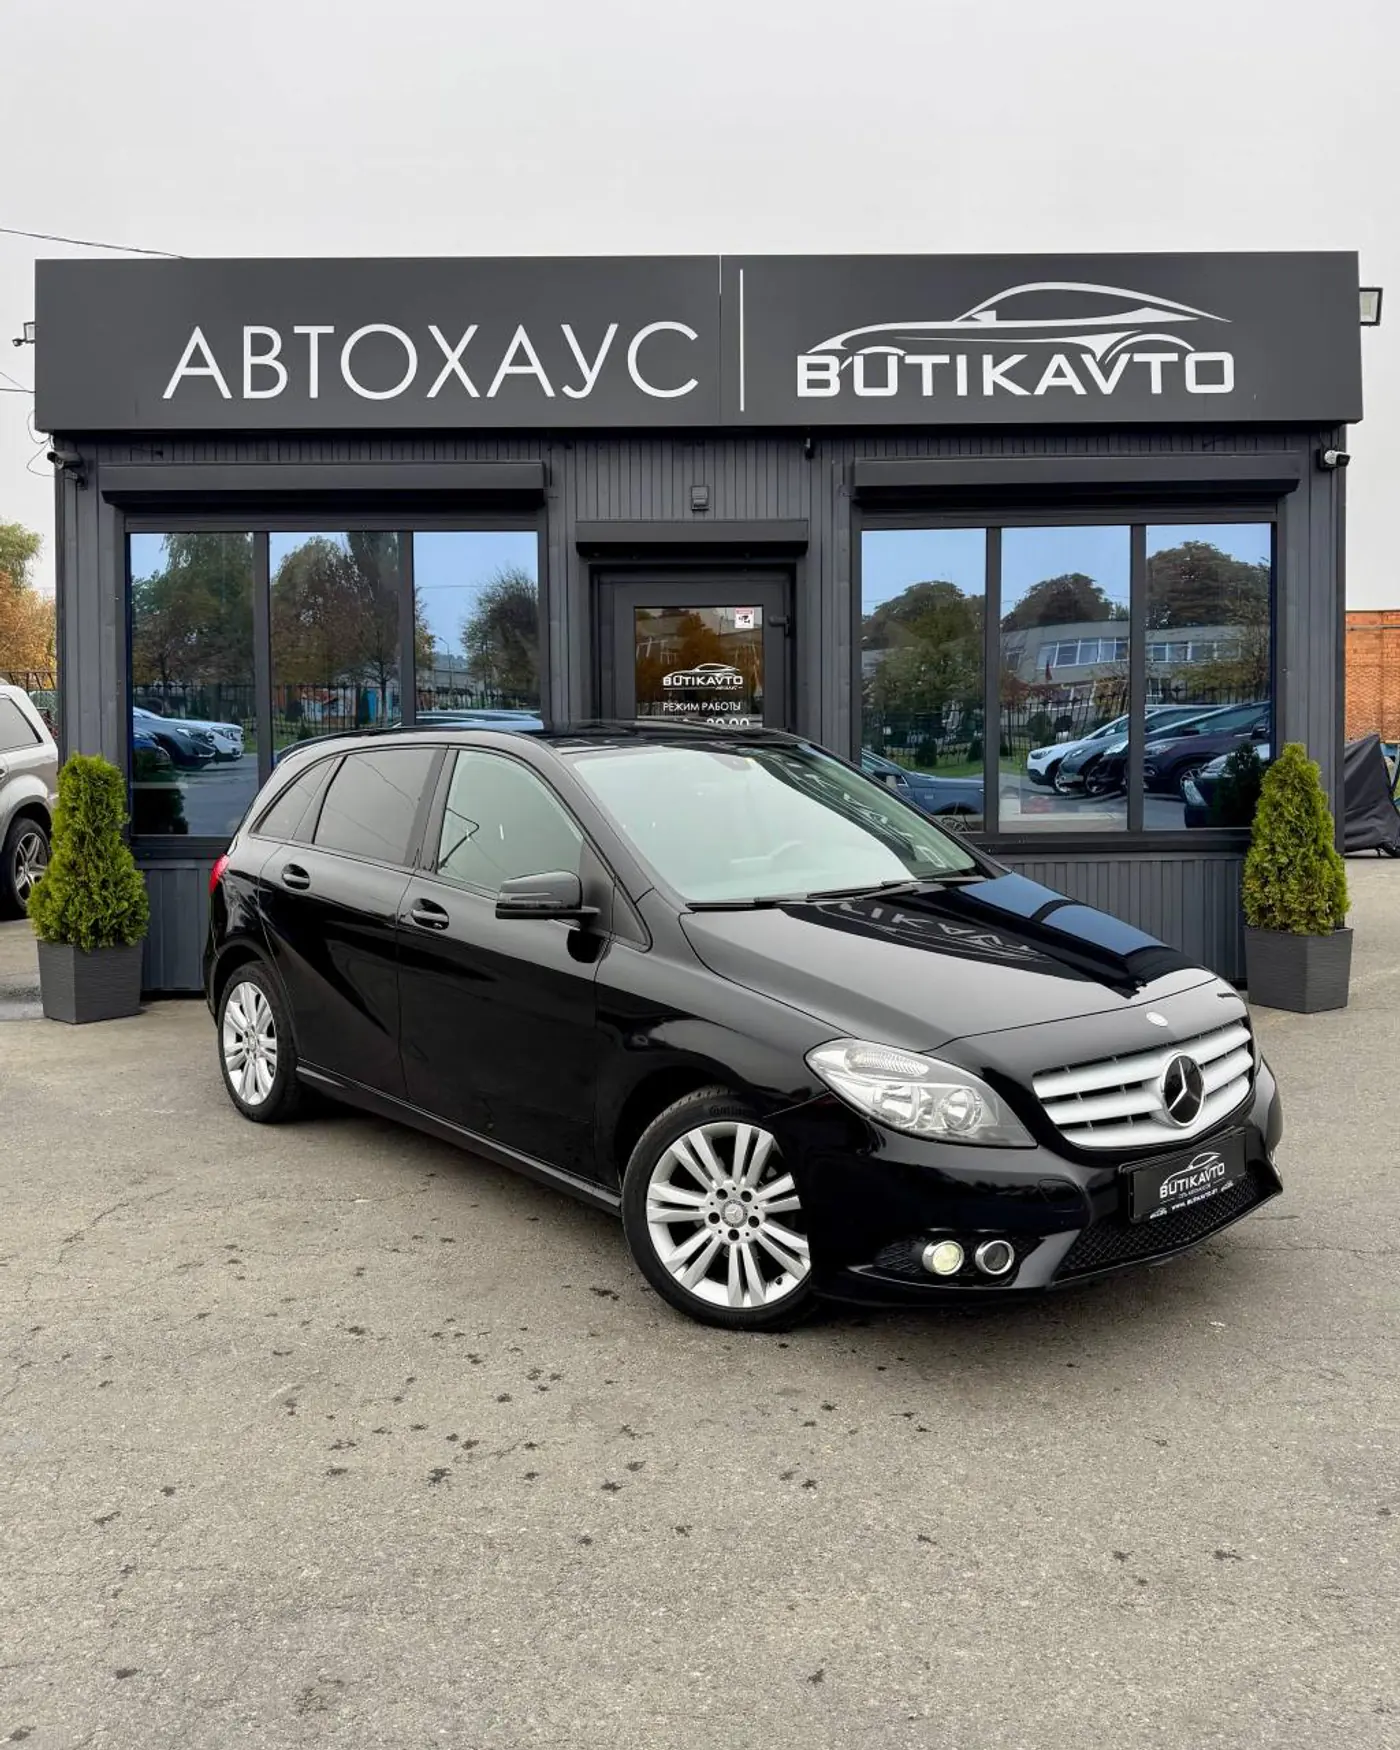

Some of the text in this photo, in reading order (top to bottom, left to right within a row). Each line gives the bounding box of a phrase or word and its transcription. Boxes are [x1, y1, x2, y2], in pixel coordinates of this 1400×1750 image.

[163, 322, 699, 400] АВТОХАУС
[797, 351, 1235, 398] BUTIKAVTO
[663, 675, 743, 686] BUTIKAVTO
[663, 702, 741, 712] РЕЖИМ РАБОТЫ
[1160, 1163, 1225, 1198] BUTIKAVTO
